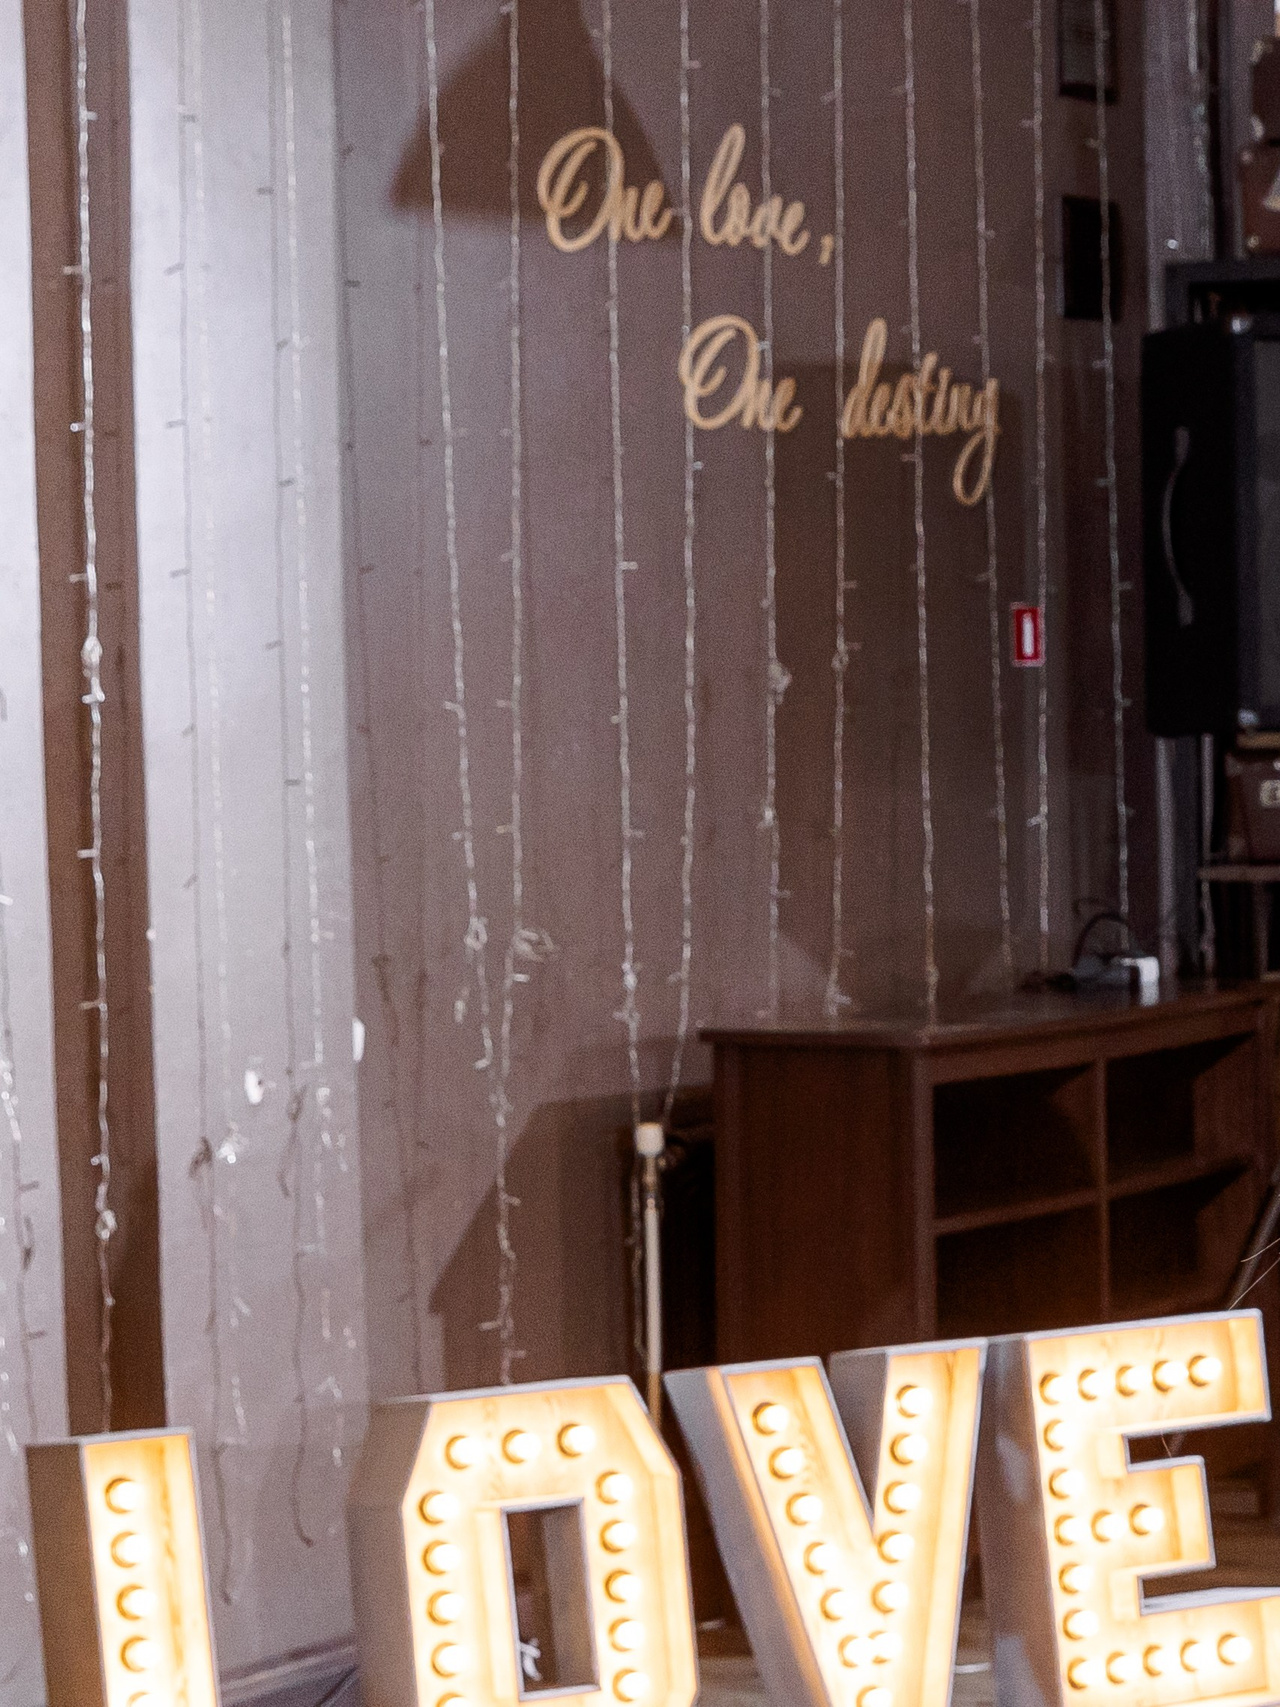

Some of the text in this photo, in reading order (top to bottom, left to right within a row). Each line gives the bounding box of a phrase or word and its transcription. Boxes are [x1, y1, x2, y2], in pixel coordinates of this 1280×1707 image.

[537, 122, 835, 265] One love,
[679, 315, 1000, 506] One destiny
